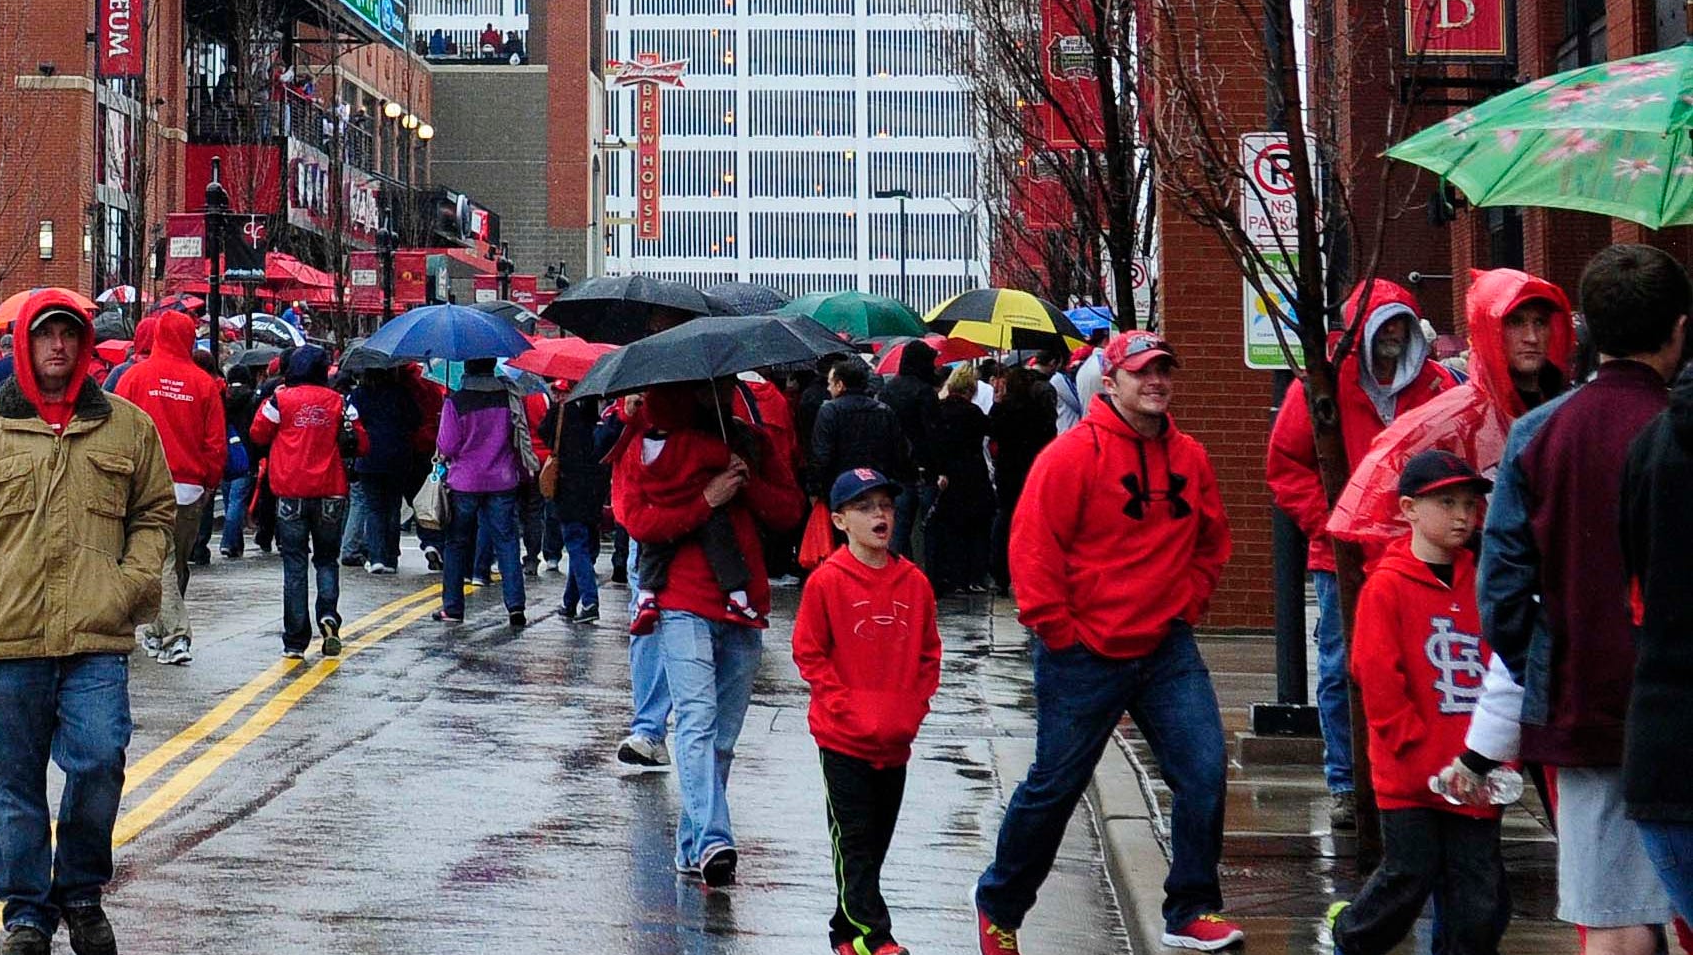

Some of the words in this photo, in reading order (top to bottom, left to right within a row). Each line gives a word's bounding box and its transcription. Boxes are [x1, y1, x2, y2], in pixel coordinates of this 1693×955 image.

[641, 83, 654, 145] BREW
[641, 155, 654, 233] HOUSE
[1271, 199, 1292, 214] NO
